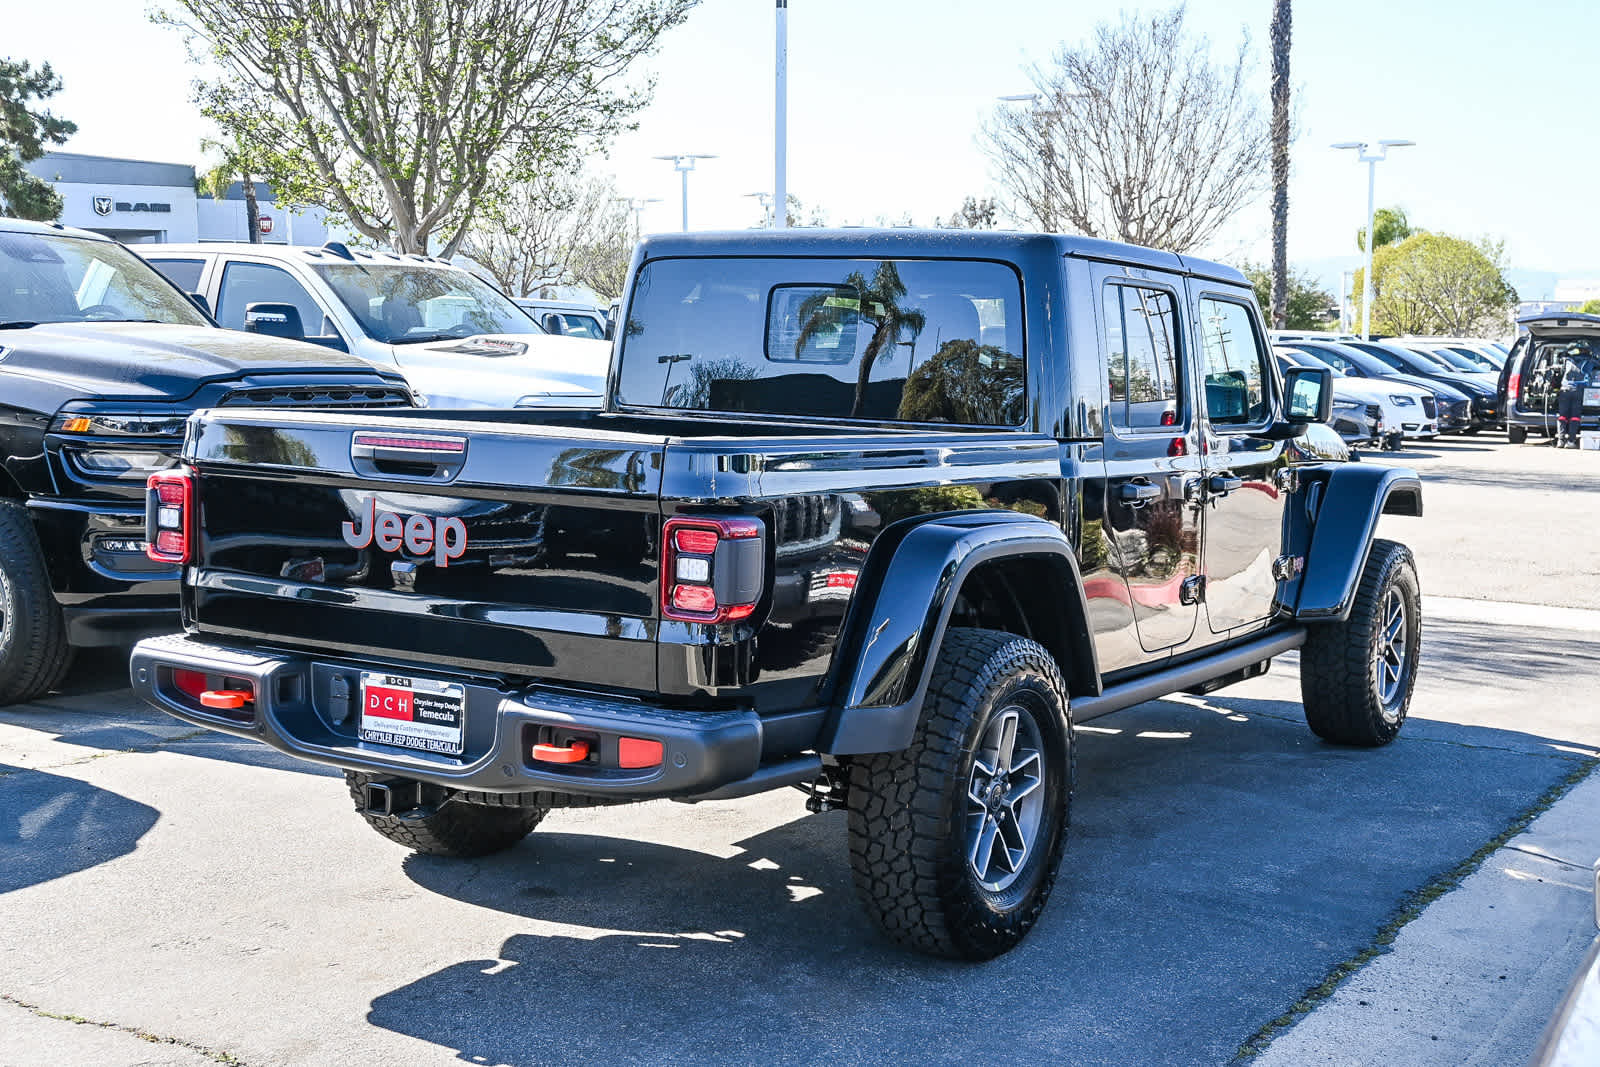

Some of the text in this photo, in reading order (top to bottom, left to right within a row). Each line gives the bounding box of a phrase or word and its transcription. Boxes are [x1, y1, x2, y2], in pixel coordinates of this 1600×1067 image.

[116, 202, 171, 212] RAM
[342, 497, 467, 568] Jeep
[390, 677, 409, 686] DCH
[370, 694, 408, 713] DCH
[413, 698, 460, 711] Chrysler Jeep Dodge
[419, 708, 454, 721] Temecula
[364, 731, 457, 752] CHRYSLER JEEP DODGE TEMECULA
